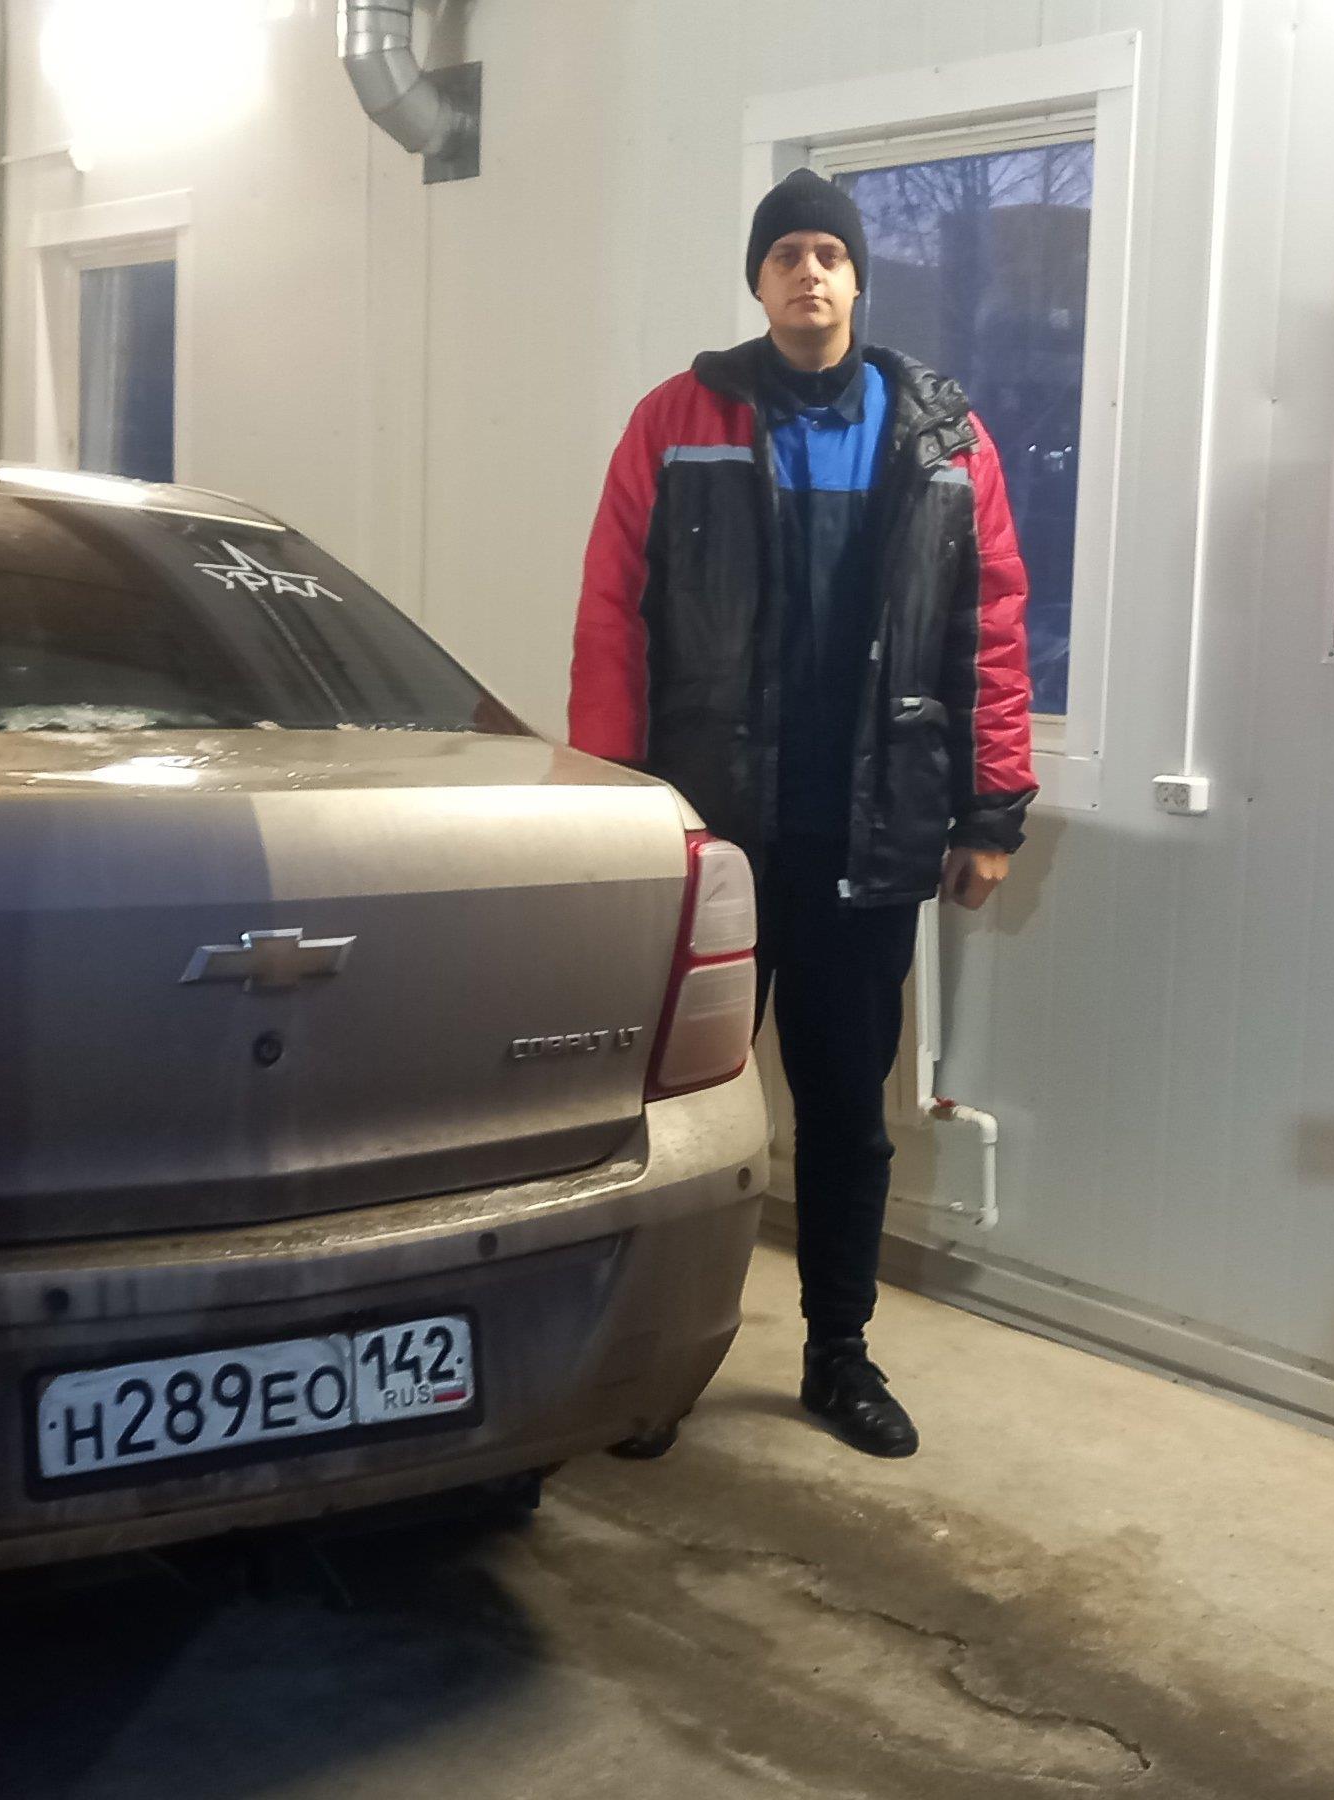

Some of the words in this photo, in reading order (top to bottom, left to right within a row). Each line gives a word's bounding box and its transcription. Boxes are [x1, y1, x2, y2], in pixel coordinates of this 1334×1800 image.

[512, 1030, 609, 1059] COBALT
[617, 1025, 644, 1048] LT
[64, 1361, 347, 1466] Н289ЕО
[360, 1325, 456, 1392] 142
[383, 1385, 432, 1411] RUS
